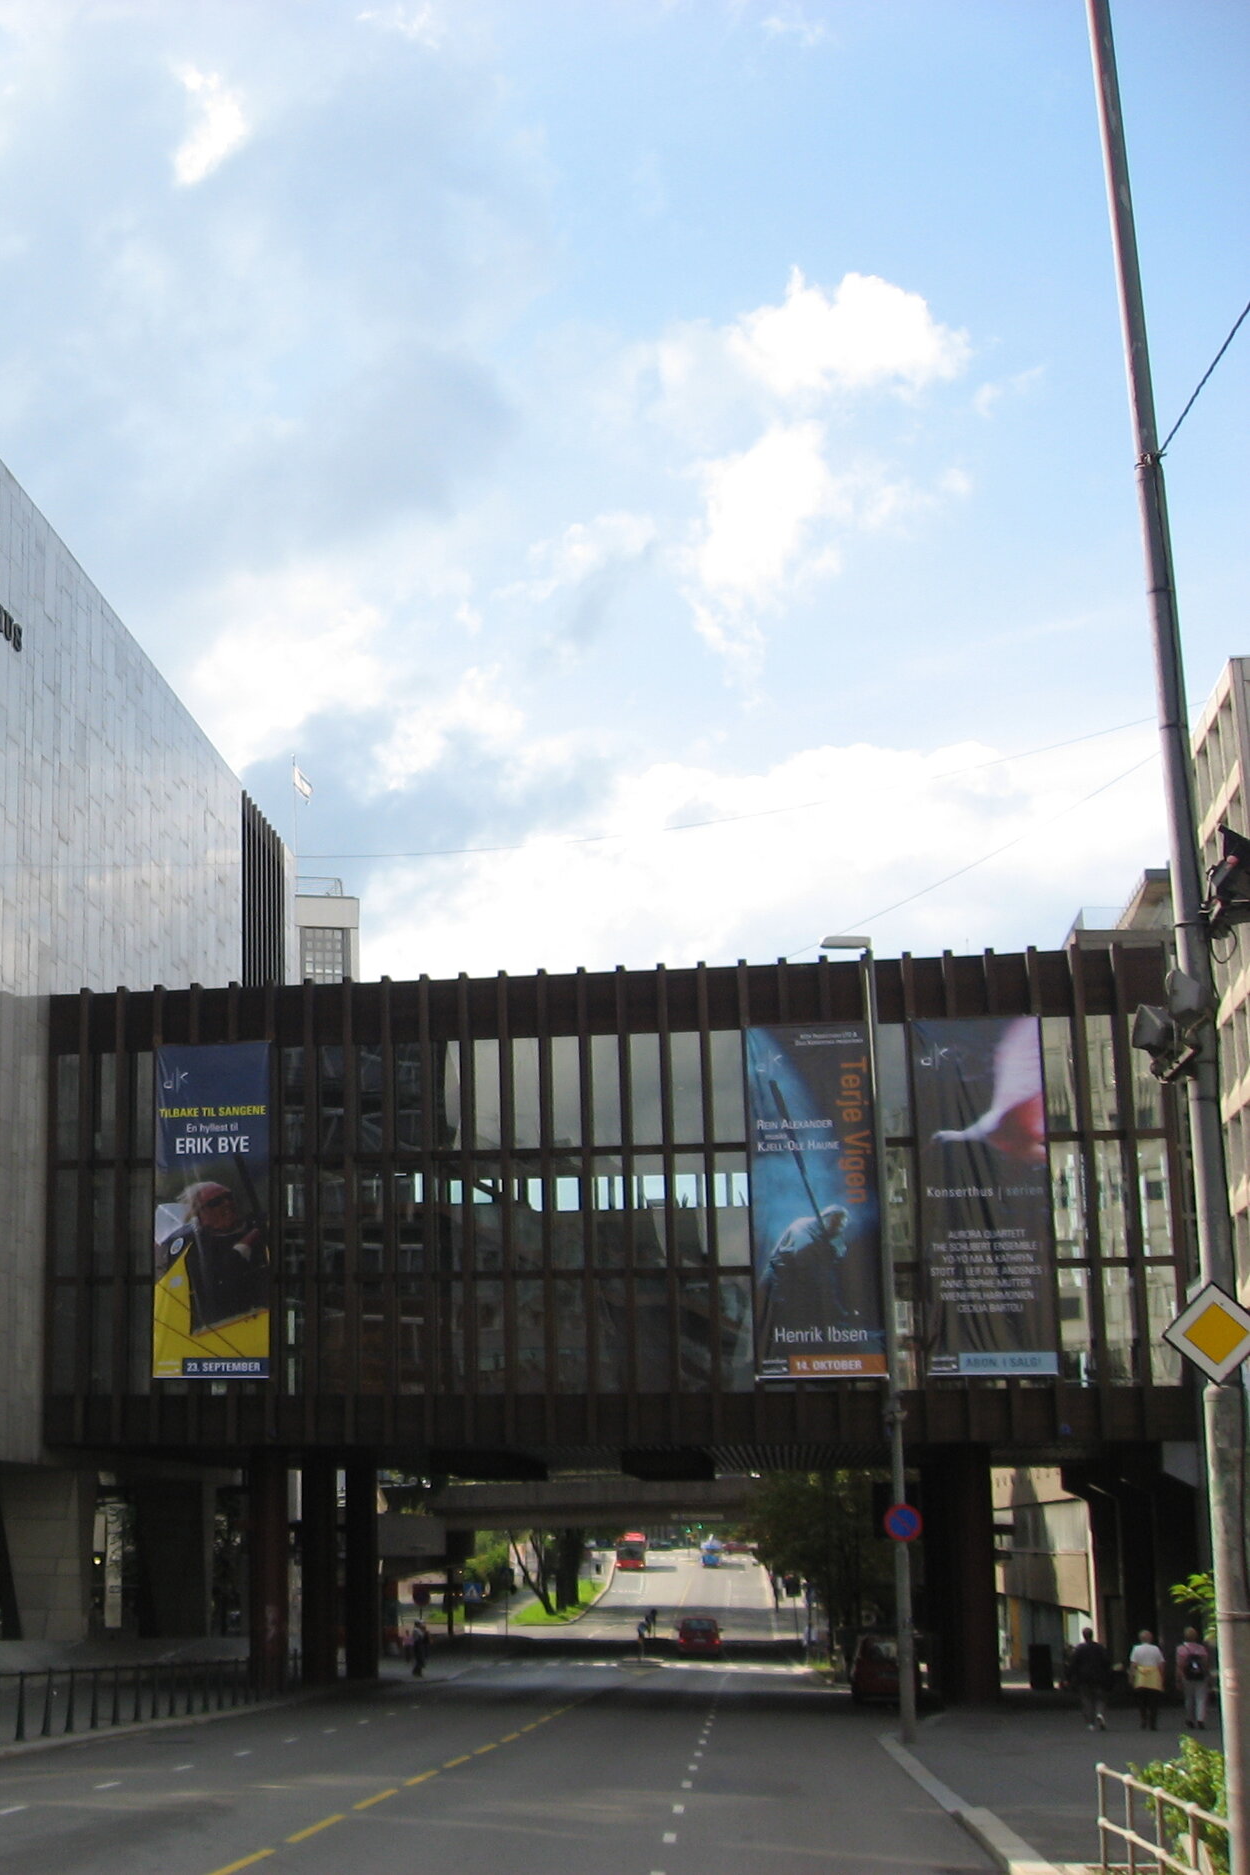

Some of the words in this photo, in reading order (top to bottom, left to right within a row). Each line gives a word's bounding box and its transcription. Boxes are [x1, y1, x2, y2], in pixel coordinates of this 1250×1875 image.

[835, 1056, 869, 1122] Terje
[159, 1107, 199, 1118] TILBAKE
[202, 1107, 216, 1117] TIL
[219, 1105, 267, 1117] SANGENE
[186, 1123, 197, 1133] En
[199, 1123, 228, 1134] hyllest
[230, 1122, 239, 1131] til
[175, 1137, 213, 1155] ERIK
[217, 1136, 250, 1153] BYE
[838, 1130, 872, 1203] Vigen
[926, 1186, 994, 1198] Konserthus
[1006, 1185, 1044, 1195] serien
[774, 1326, 823, 1343] Henrik
[828, 1326, 868, 1341] Ibsen
[186, 1362, 199, 1372] 23.
[202, 1362, 261, 1372] SEPTEMBER
[796, 1361, 810, 1370] 14.
[813, 1360, 862, 1370] OKTOBER
